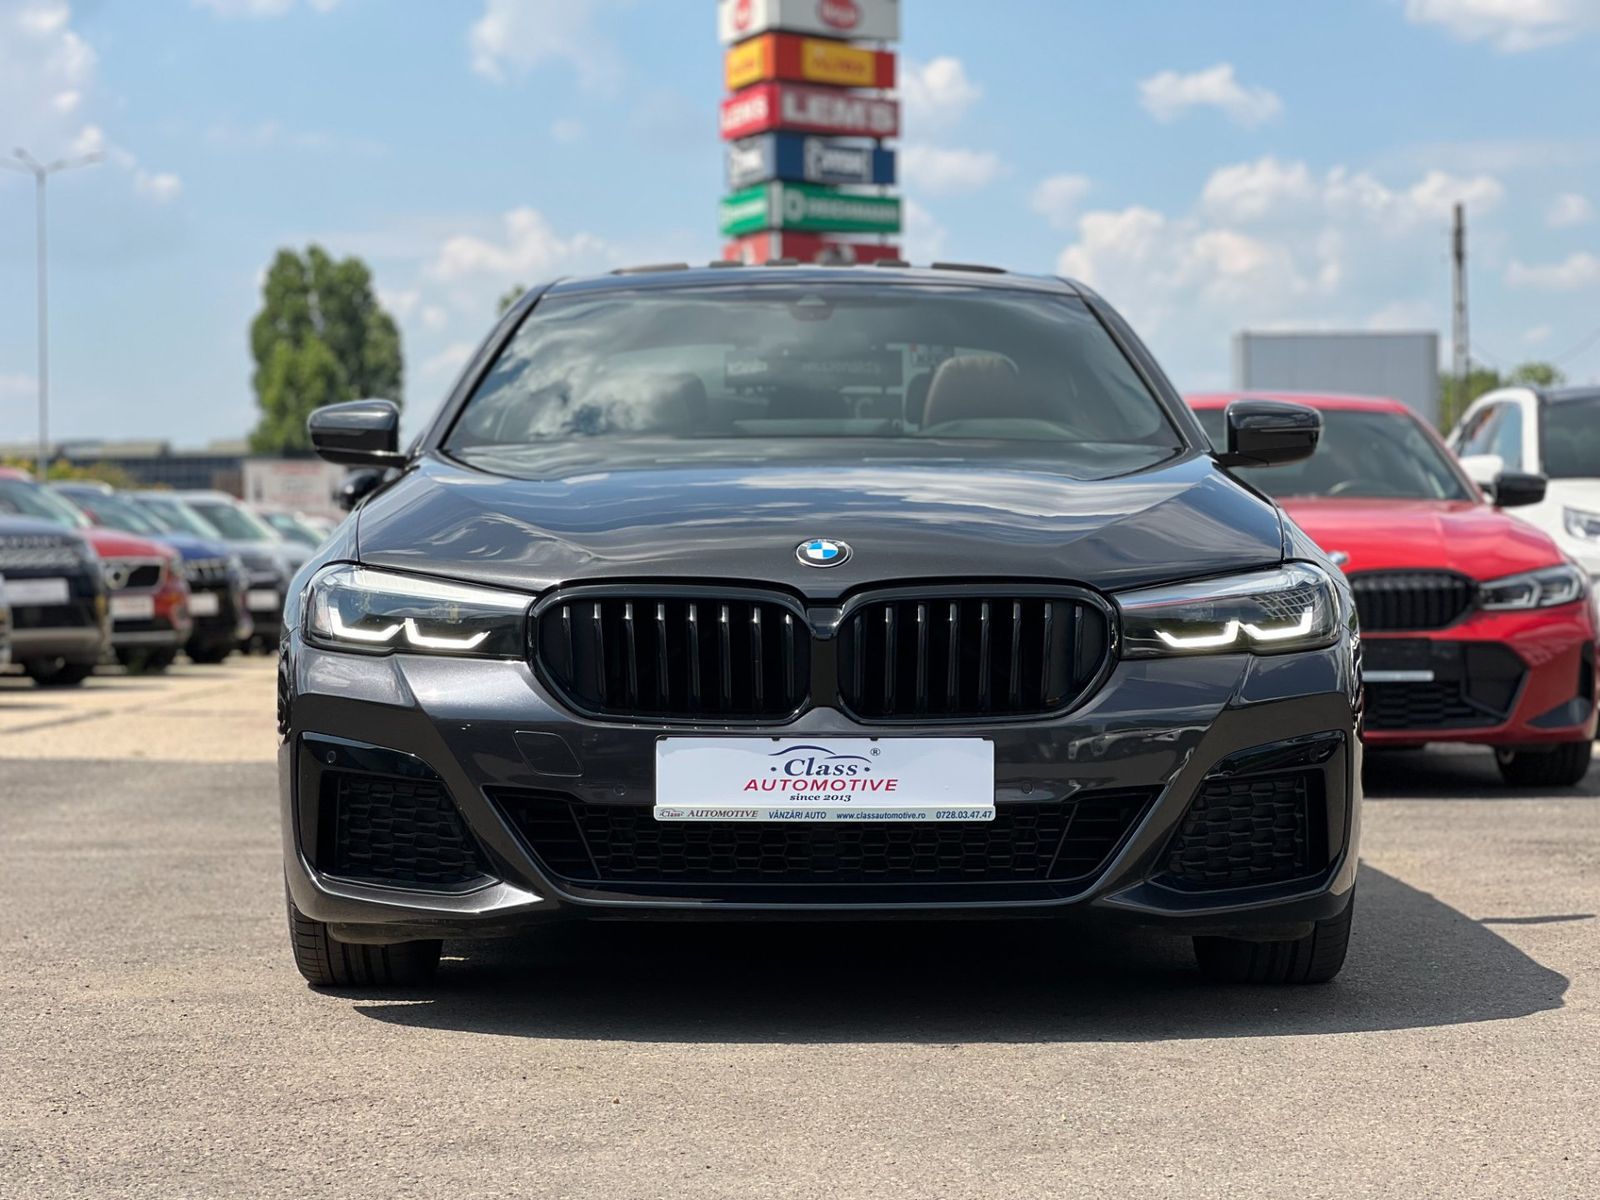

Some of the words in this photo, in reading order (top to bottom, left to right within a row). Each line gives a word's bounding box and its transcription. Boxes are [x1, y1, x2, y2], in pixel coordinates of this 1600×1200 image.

[784, 757, 858, 777] Class
[744, 779, 898, 792] AUTOMOTIVE
[789, 793, 820, 801] since
[823, 794, 852, 802] 2013
[688, 809, 759, 818] AUTOMOTIVE
[804, 811, 827, 819] AUTO
[836, 811, 926, 820] www.classautomotive.ro
[936, 810, 993, 820] 0728.03.47.47
